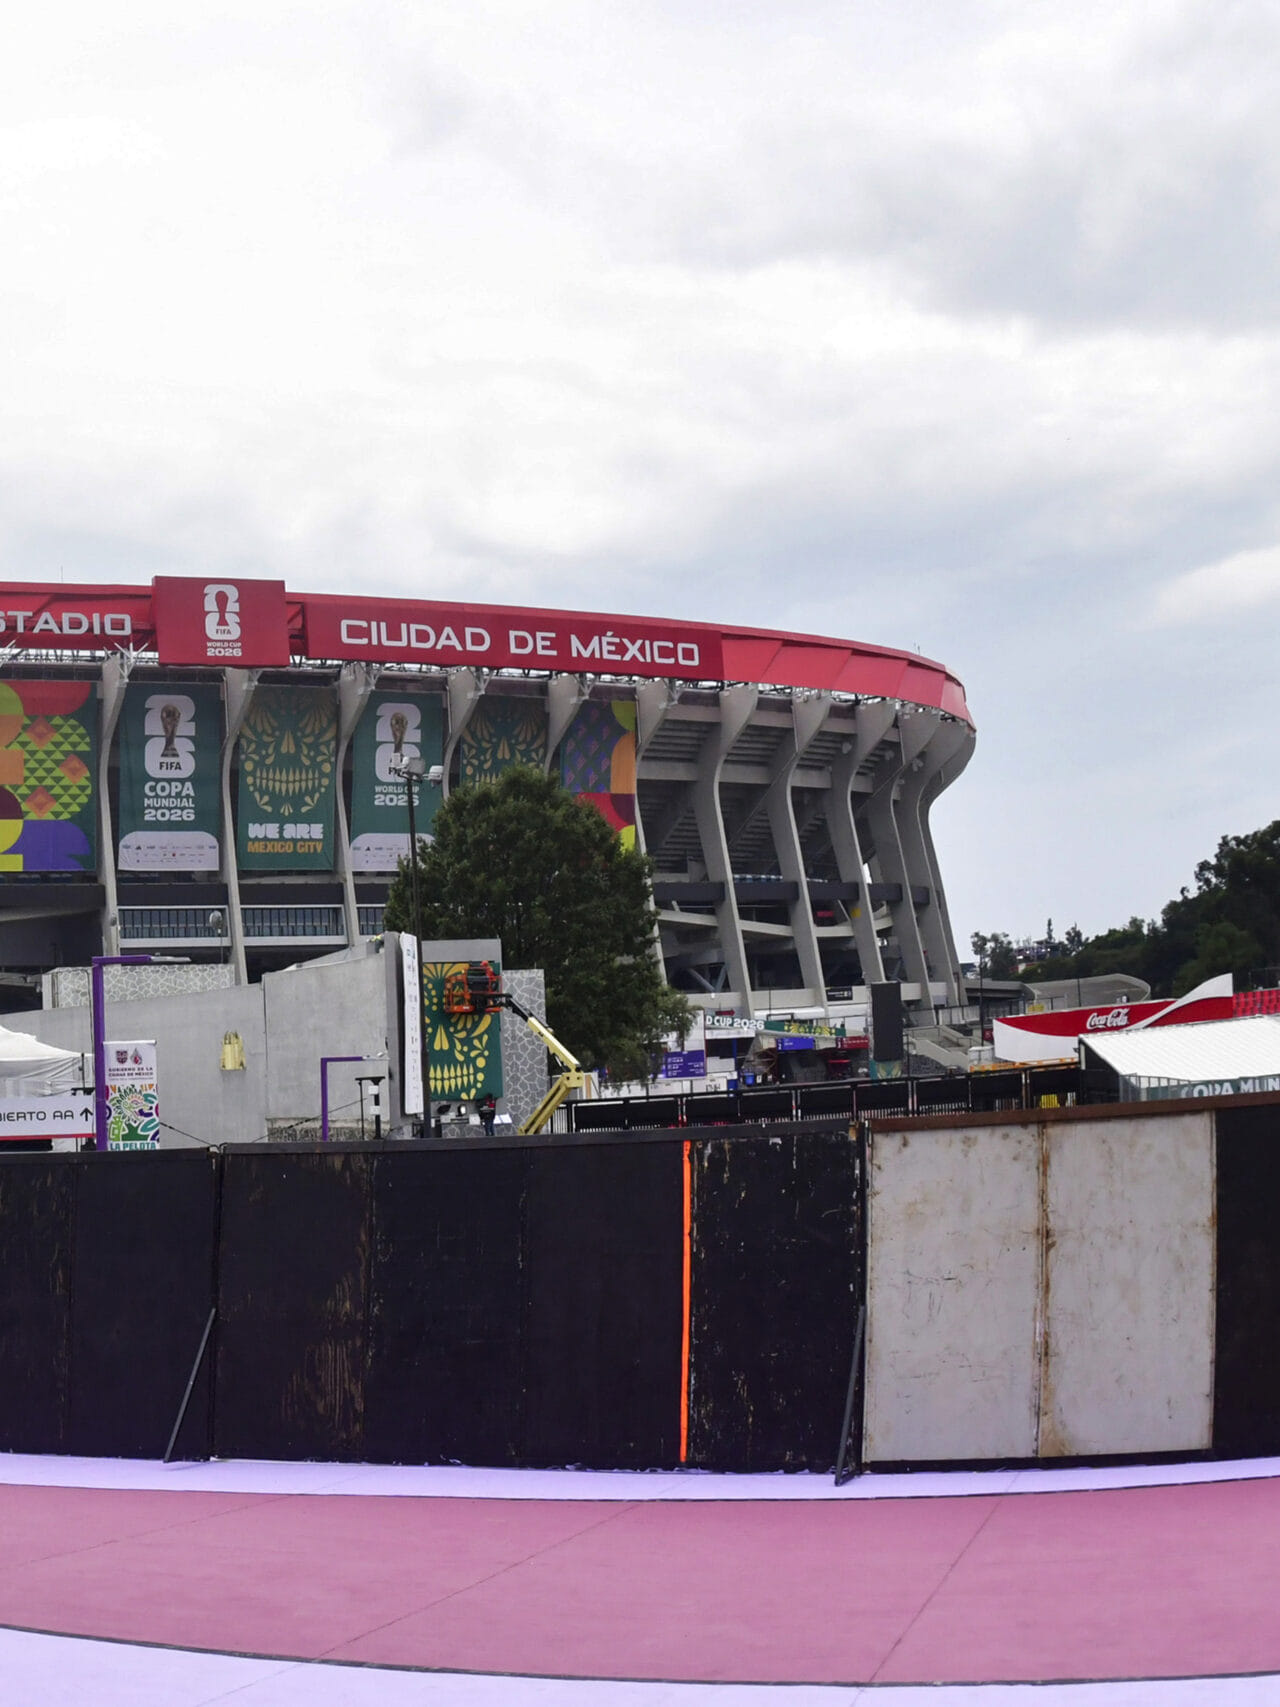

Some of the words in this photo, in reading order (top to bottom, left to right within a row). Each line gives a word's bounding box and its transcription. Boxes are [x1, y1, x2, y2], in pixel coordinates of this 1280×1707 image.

[340, 619, 491, 651] CIUDAD
[508, 629, 557, 656] DE
[570, 631, 700, 666] MÉXICO
[206, 648, 242, 656] 2026
[159, 761, 182, 771] FIFA
[144, 781, 195, 796] COPA
[374, 785, 403, 793] WORLD
[144, 797, 195, 807] MUNDIAL
[144, 809, 196, 821] 2026
[248, 823, 280, 839] WE
[247, 841, 294, 853] MEXICO
[296, 841, 323, 853] CITY
[714, 1015, 732, 1027] CUP
[733, 1018, 765, 1030] 2026
[1086, 1007, 1130, 1030] Coca-Cola
[53, 1110, 74, 1121] AA
[110, 1143, 120, 1151] LA
[123, 1142, 156, 1151] PELOTA
